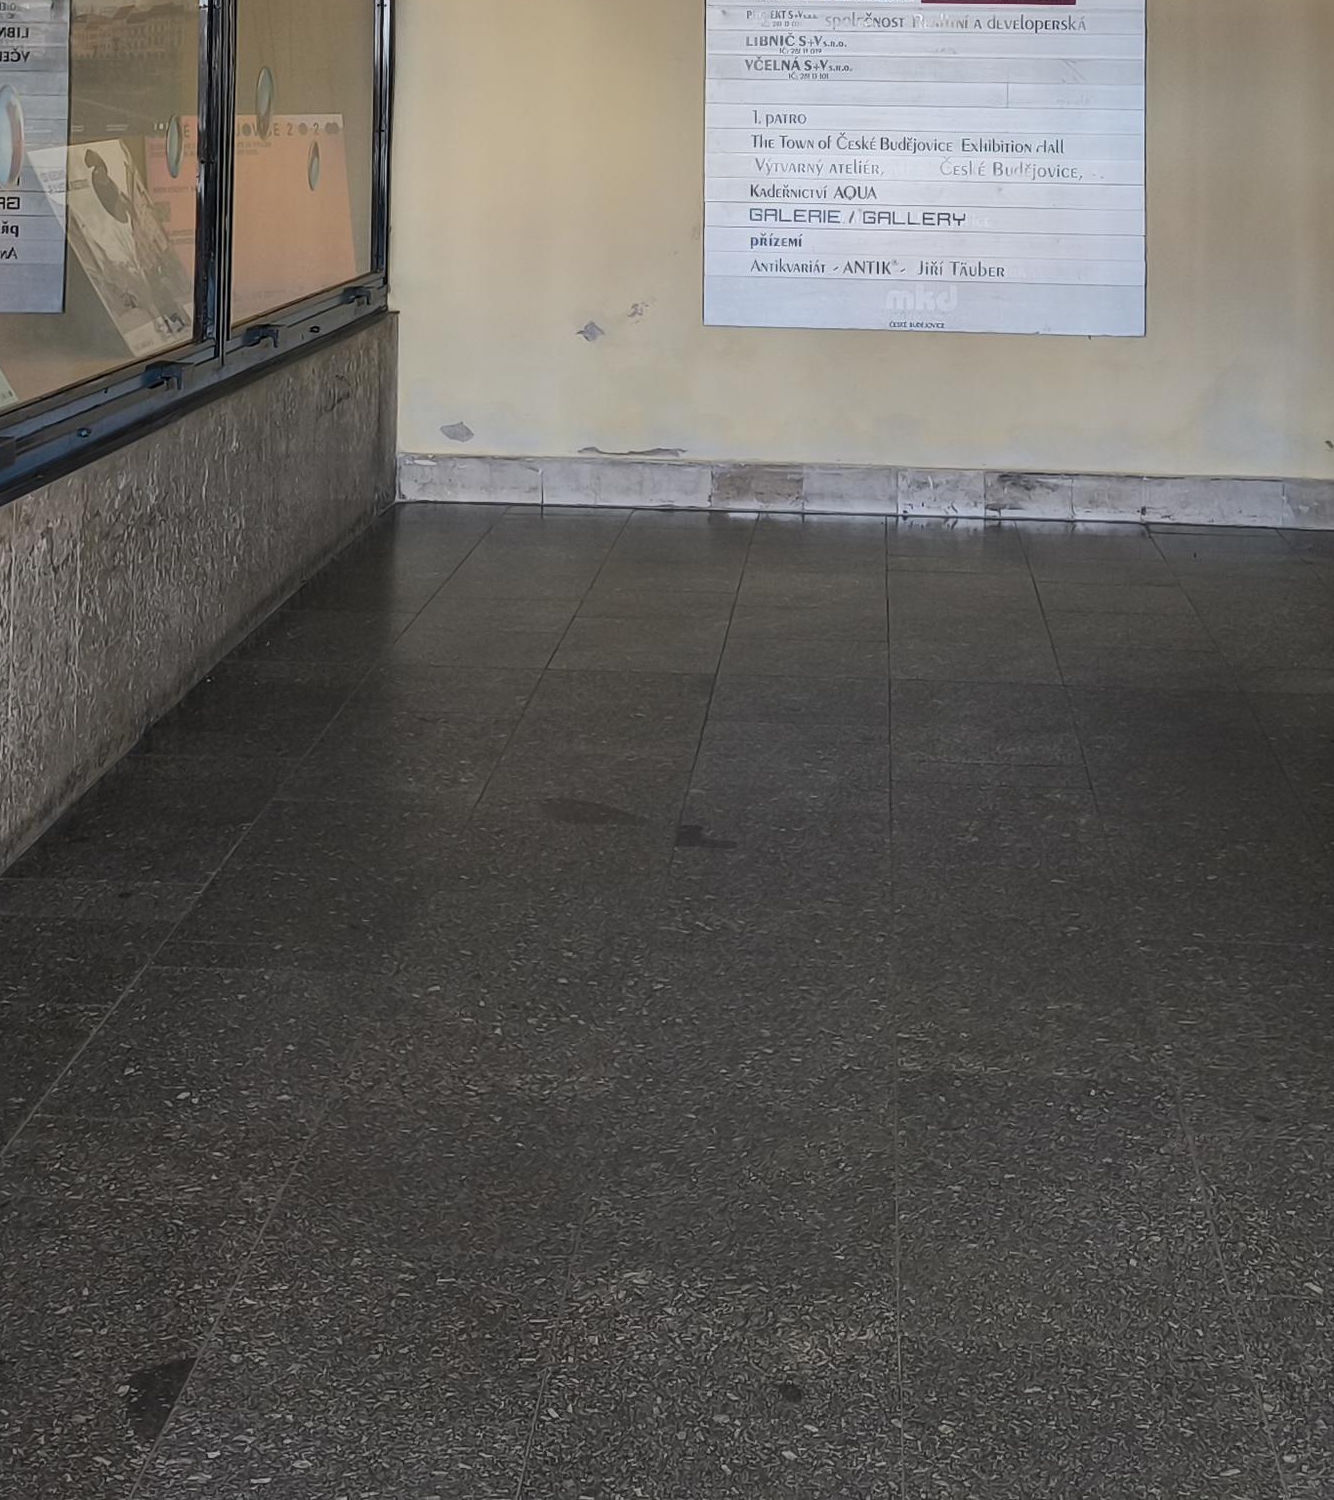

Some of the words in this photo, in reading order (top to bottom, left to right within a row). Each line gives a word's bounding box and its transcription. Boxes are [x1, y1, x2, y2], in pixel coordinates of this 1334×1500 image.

[987, 13, 1087, 33] developerská
[745, 32, 796, 47] LIBNIČ
[745, 56, 801, 71] VČELNÁ
[753, 110, 761, 124] 1.
[766, 113, 807, 127] patro
[751, 134, 775, 149] The
[779, 135, 814, 149] Town
[818, 135, 831, 150] of
[836, 132, 877, 150] České
[880, 136, 953, 154] Budějovice
[961, 138, 1032, 153] Exhibition
[755, 158, 824, 176] Výtvarný
[829, 159, 884, 175] ateliér,
[750, 184, 828, 199] Kadeřnictví
[834, 185, 877, 201] AQUA
[749, 208, 841, 224] GALERIE
[863, 211, 966, 227] GALLERY
[750, 233, 803, 250] přízemí
[750, 258, 826, 274] Antikvariát
[918, 260, 944, 276] Jiří
[949, 261, 1005, 278] Täuber
